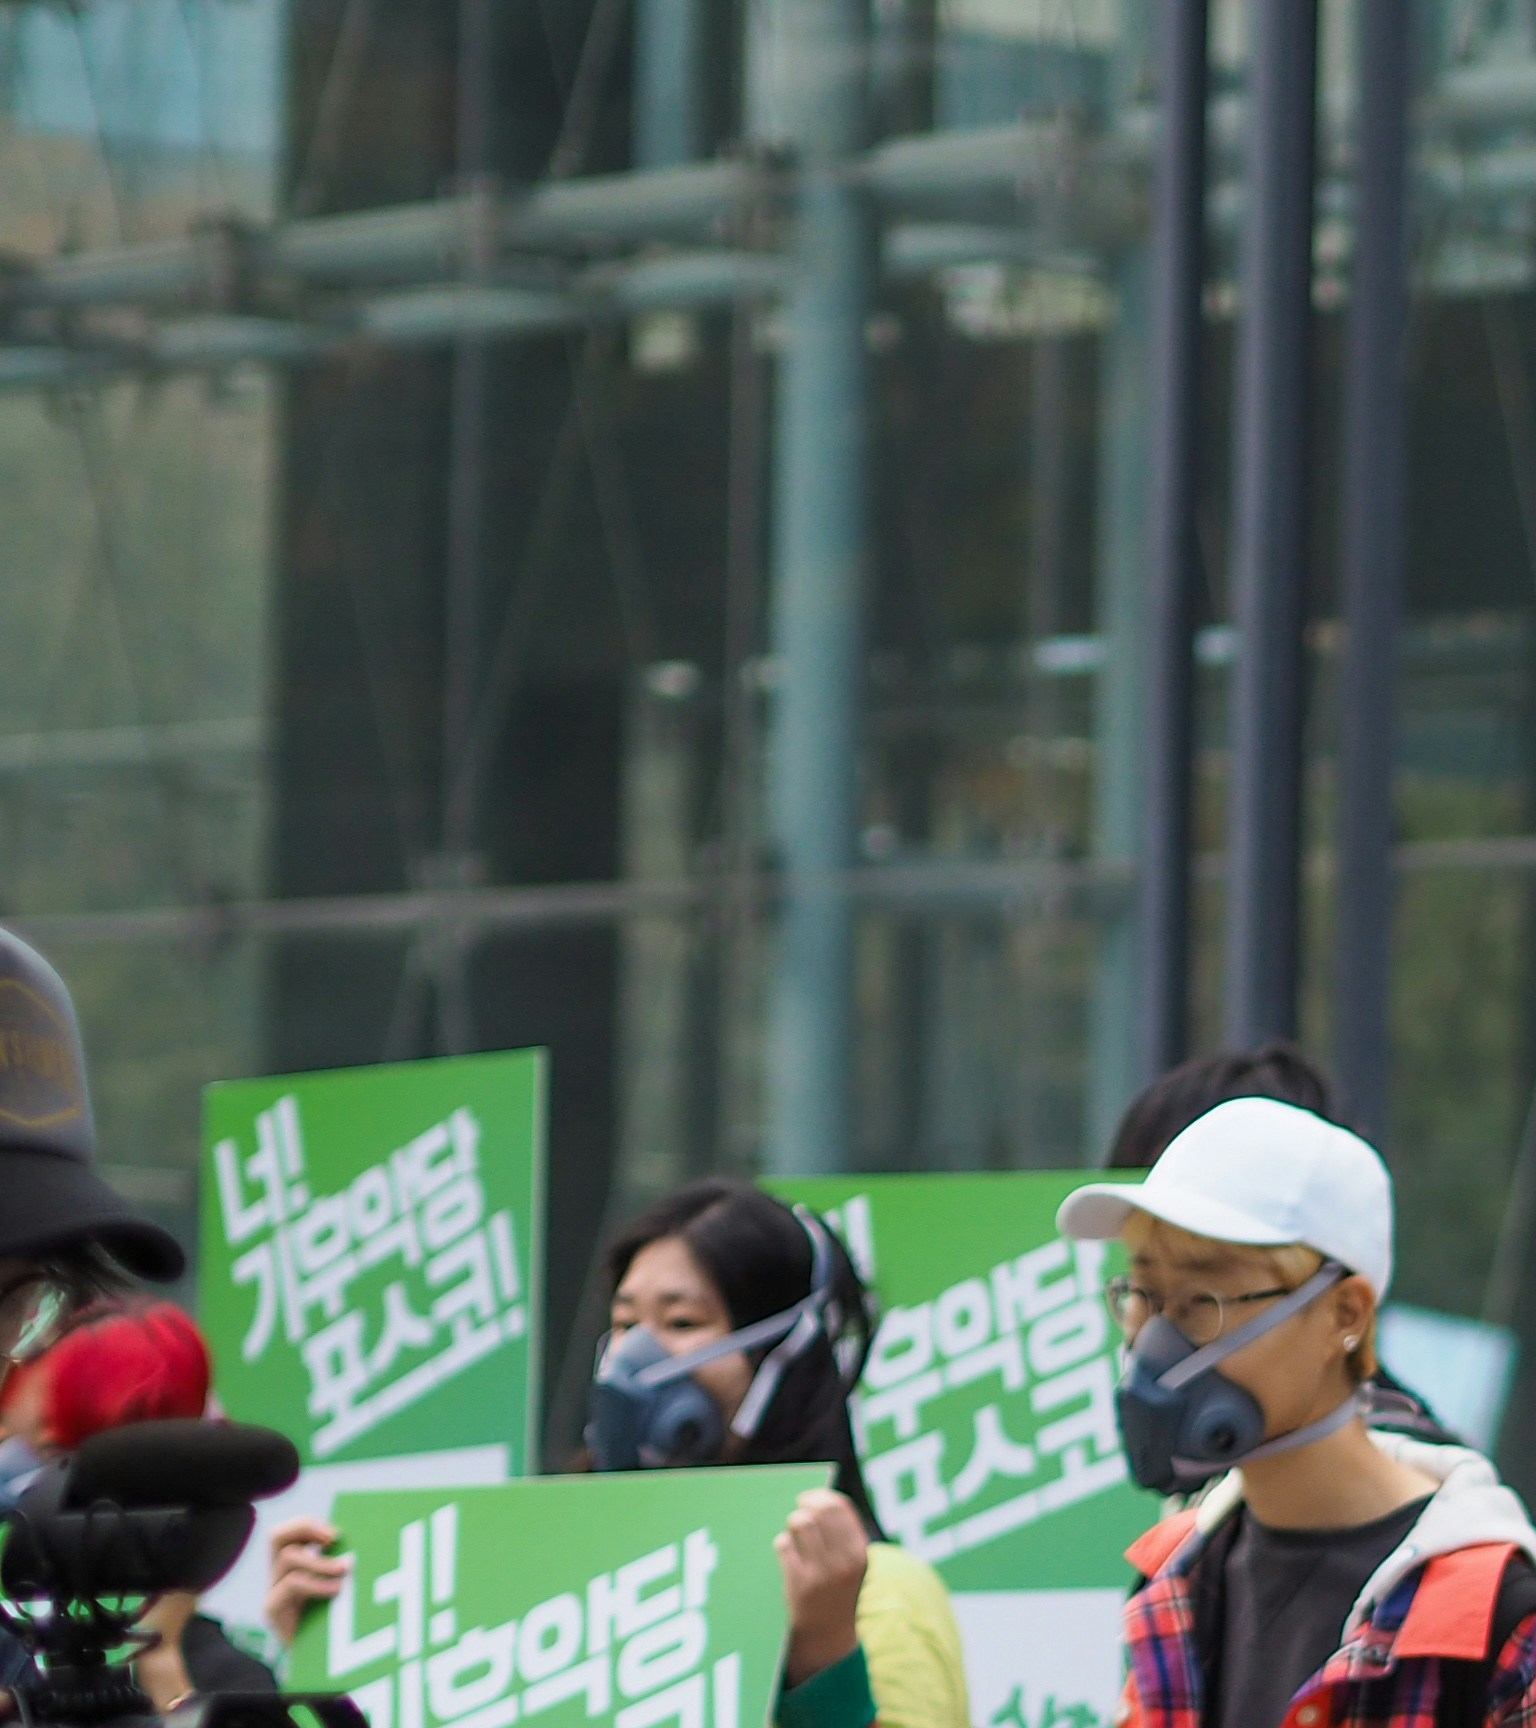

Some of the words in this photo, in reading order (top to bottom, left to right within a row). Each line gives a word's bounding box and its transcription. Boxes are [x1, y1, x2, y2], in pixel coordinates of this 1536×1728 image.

[214, 1095, 308, 1245] 너!
[233, 1106, 482, 1364] 기후악당
[305, 1209, 525, 1458] 포스코!
[847, 1238, 1108, 1456] 후악당
[864, 1345, 1129, 1563] 포스코
[327, 1503, 457, 1678] 너!
